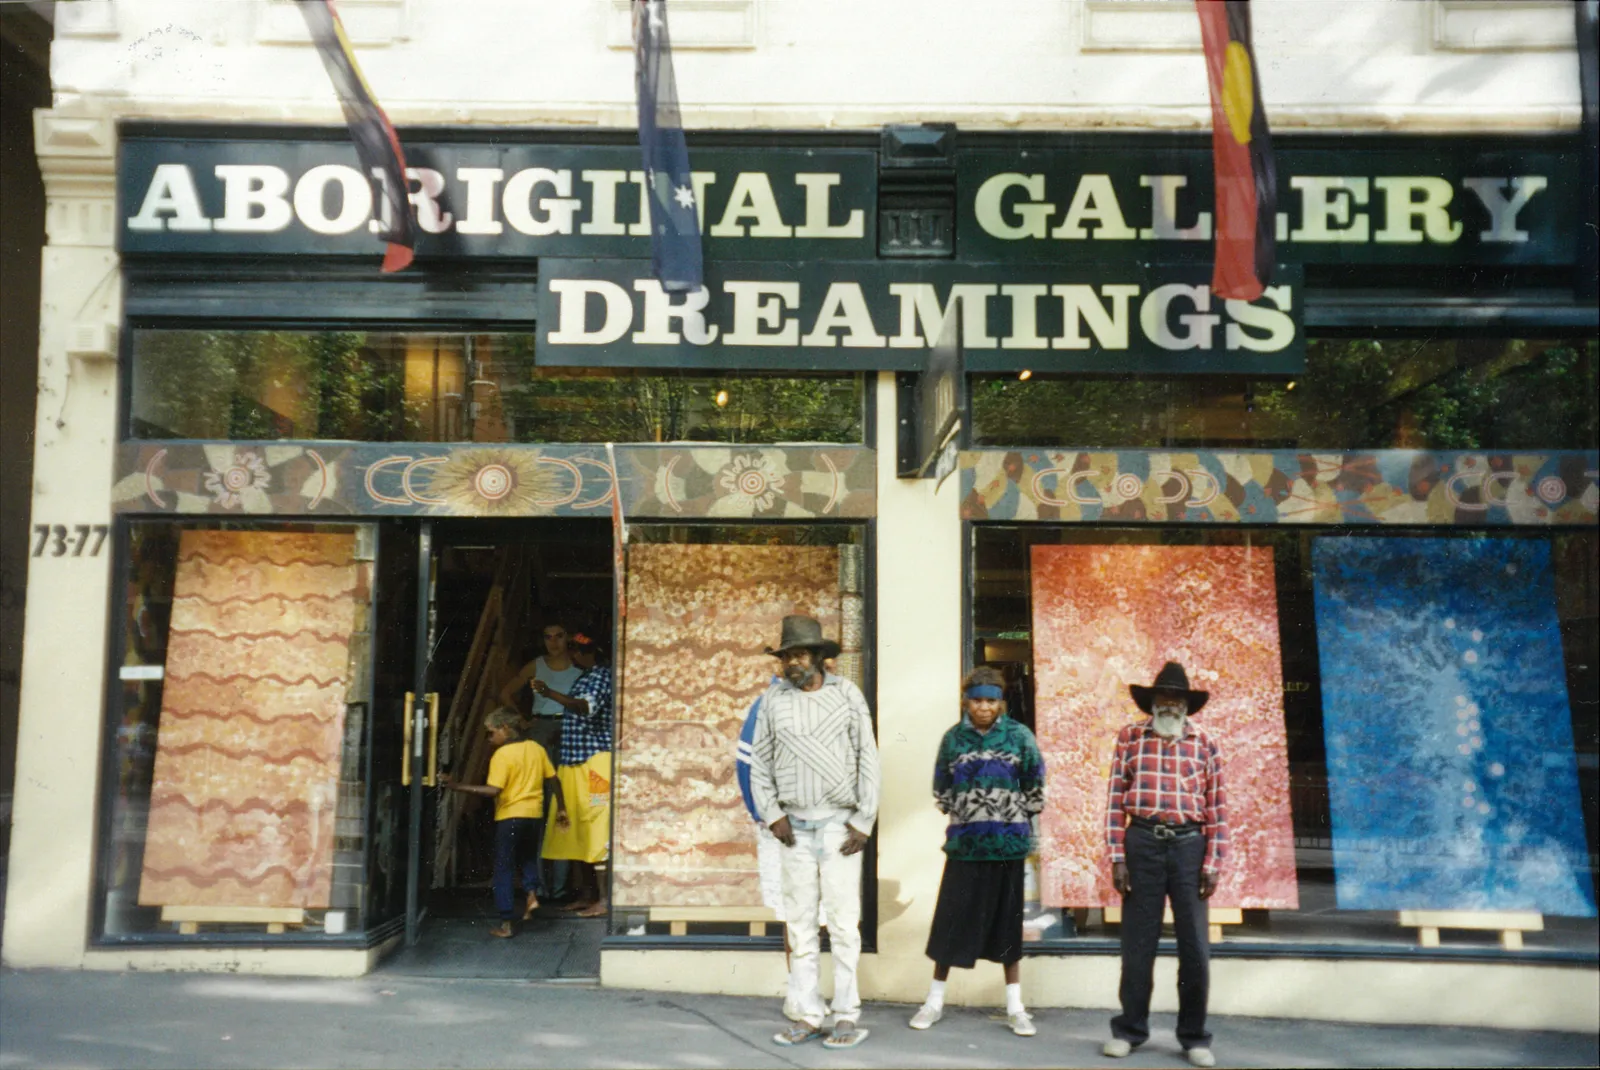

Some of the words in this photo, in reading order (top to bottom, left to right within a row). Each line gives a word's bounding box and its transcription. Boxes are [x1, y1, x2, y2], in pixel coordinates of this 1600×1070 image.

[128, 163, 865, 239] ABORIGINAL
[547, 278, 1295, 352] DREAMINGS
[32, 524, 110, 557] 73-77
